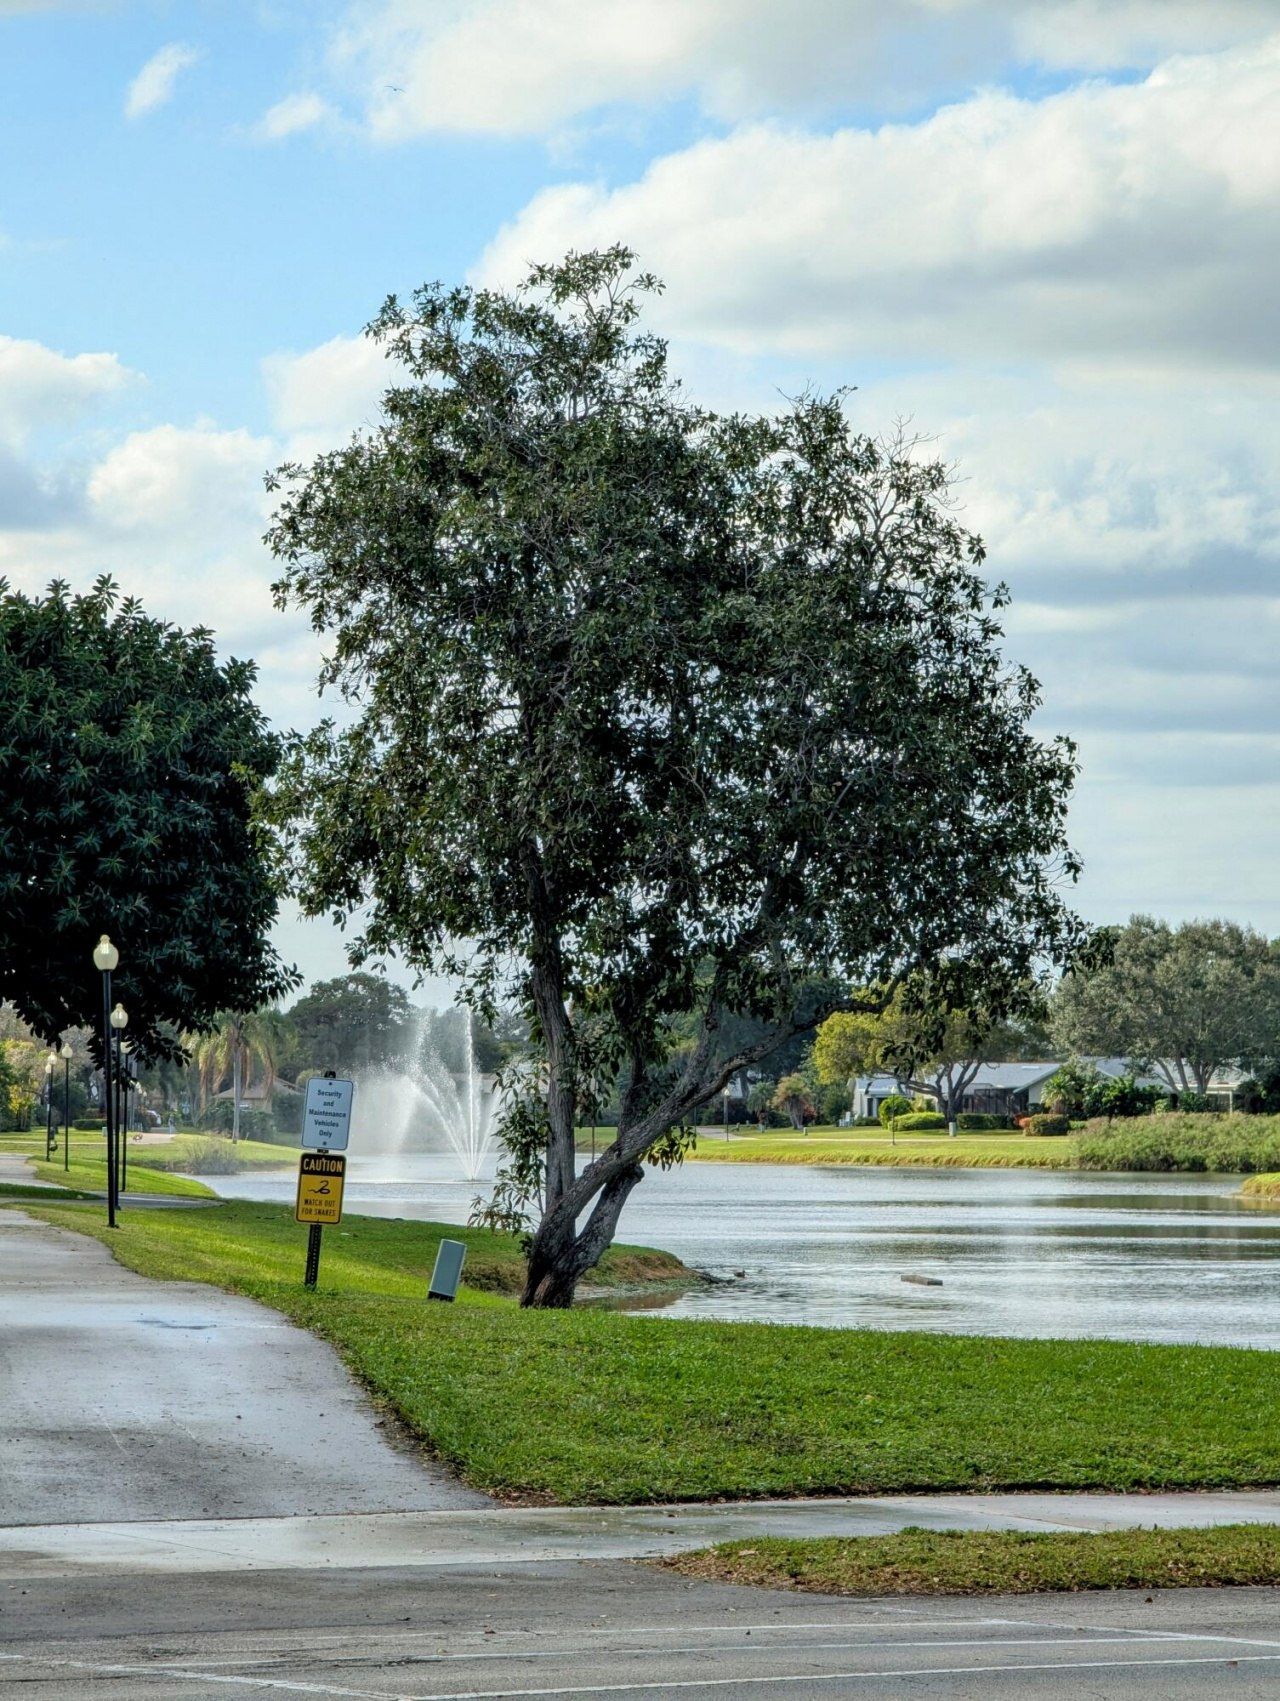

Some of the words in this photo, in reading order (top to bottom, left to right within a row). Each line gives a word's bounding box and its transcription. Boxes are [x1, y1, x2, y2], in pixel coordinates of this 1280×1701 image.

[318, 1090, 342, 1098] Security
[309, 1109, 346, 1117] Maintenance
[319, 1130, 332, 1138] Only
[303, 1159, 343, 1172] CAUTION
[302, 1207, 312, 1215] FOR
